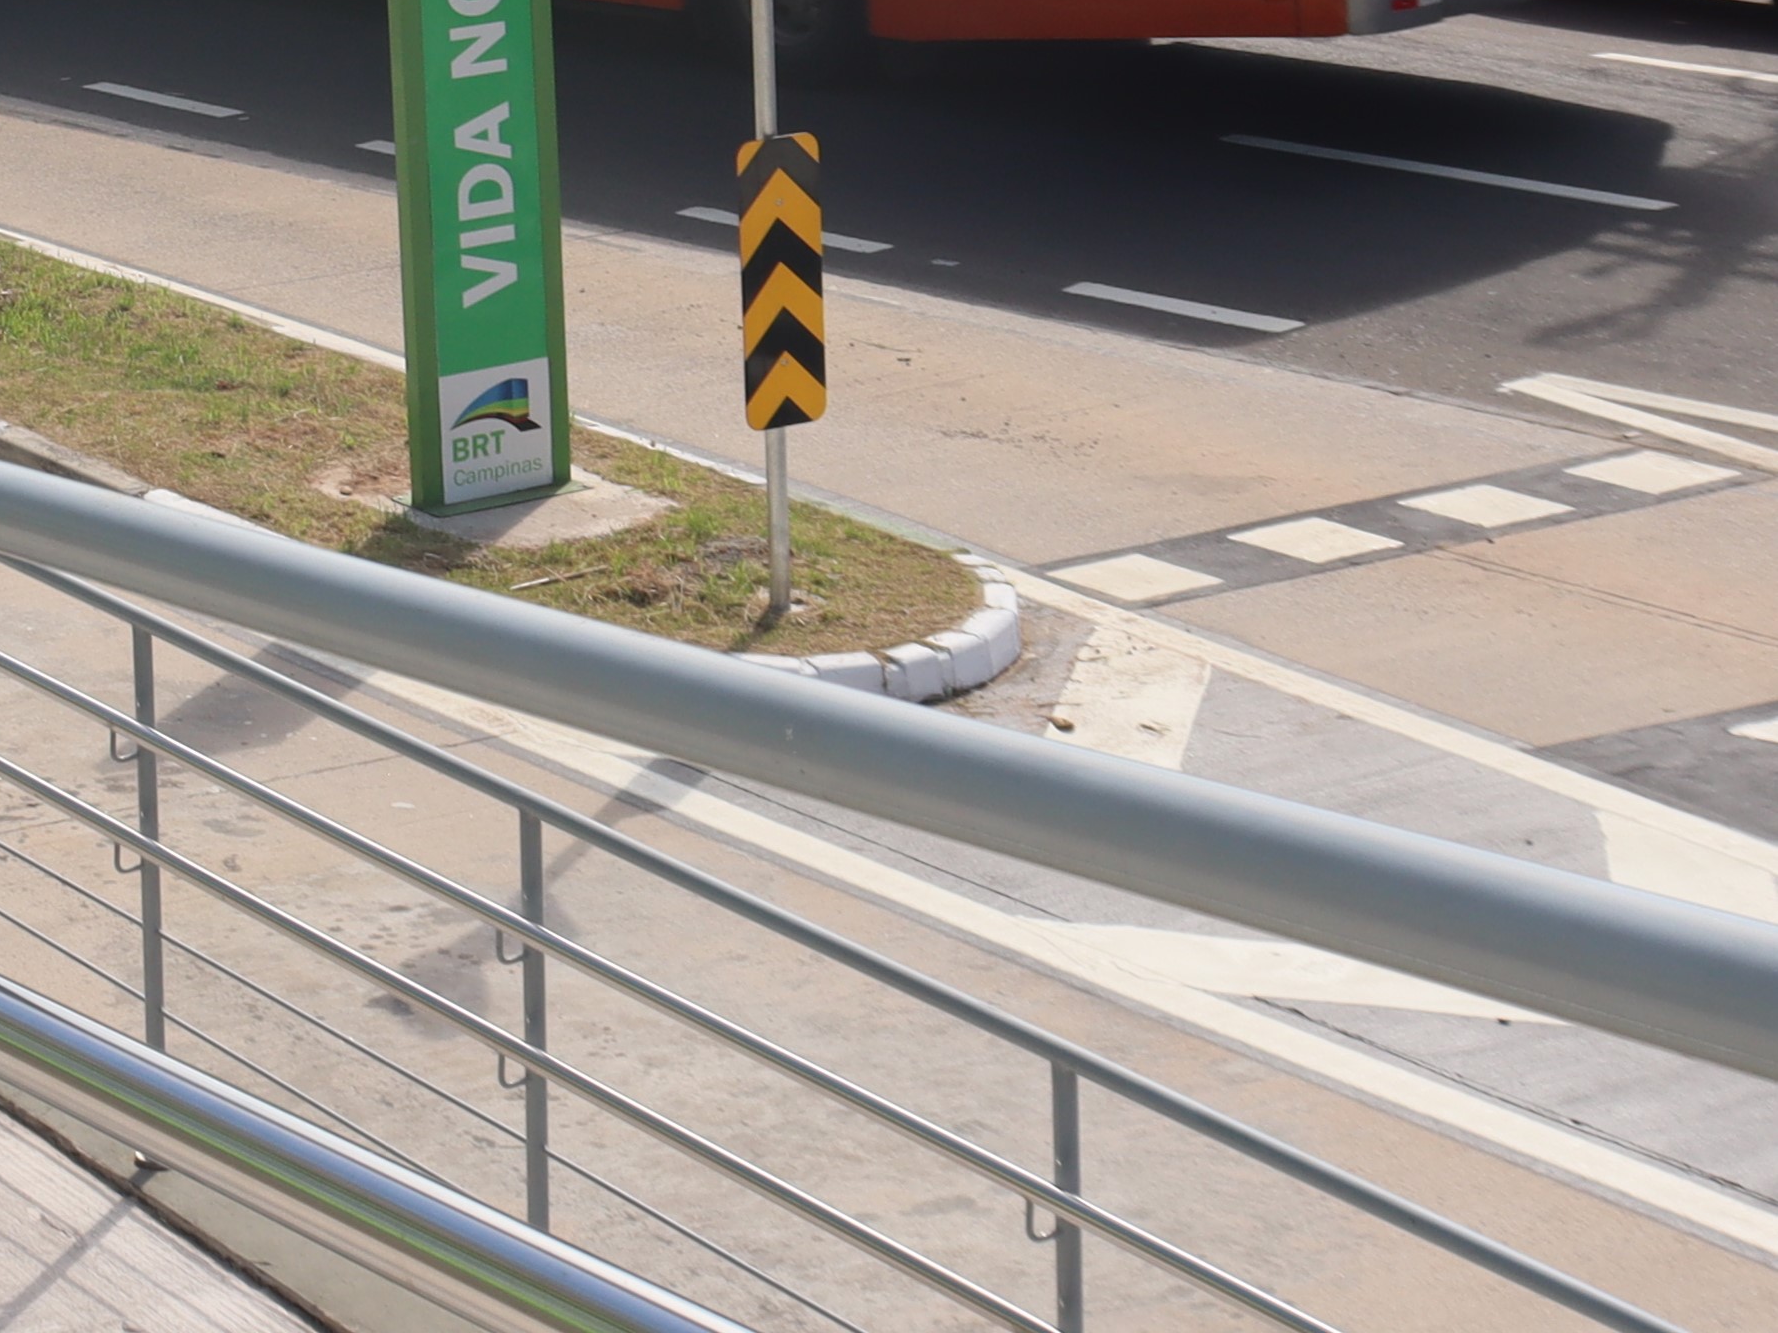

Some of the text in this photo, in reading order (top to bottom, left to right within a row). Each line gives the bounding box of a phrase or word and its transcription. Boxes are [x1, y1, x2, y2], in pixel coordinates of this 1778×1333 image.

[453, 100, 519, 310] VIDA
[452, 428, 506, 464] BRT
[453, 456, 543, 487] Campinas
